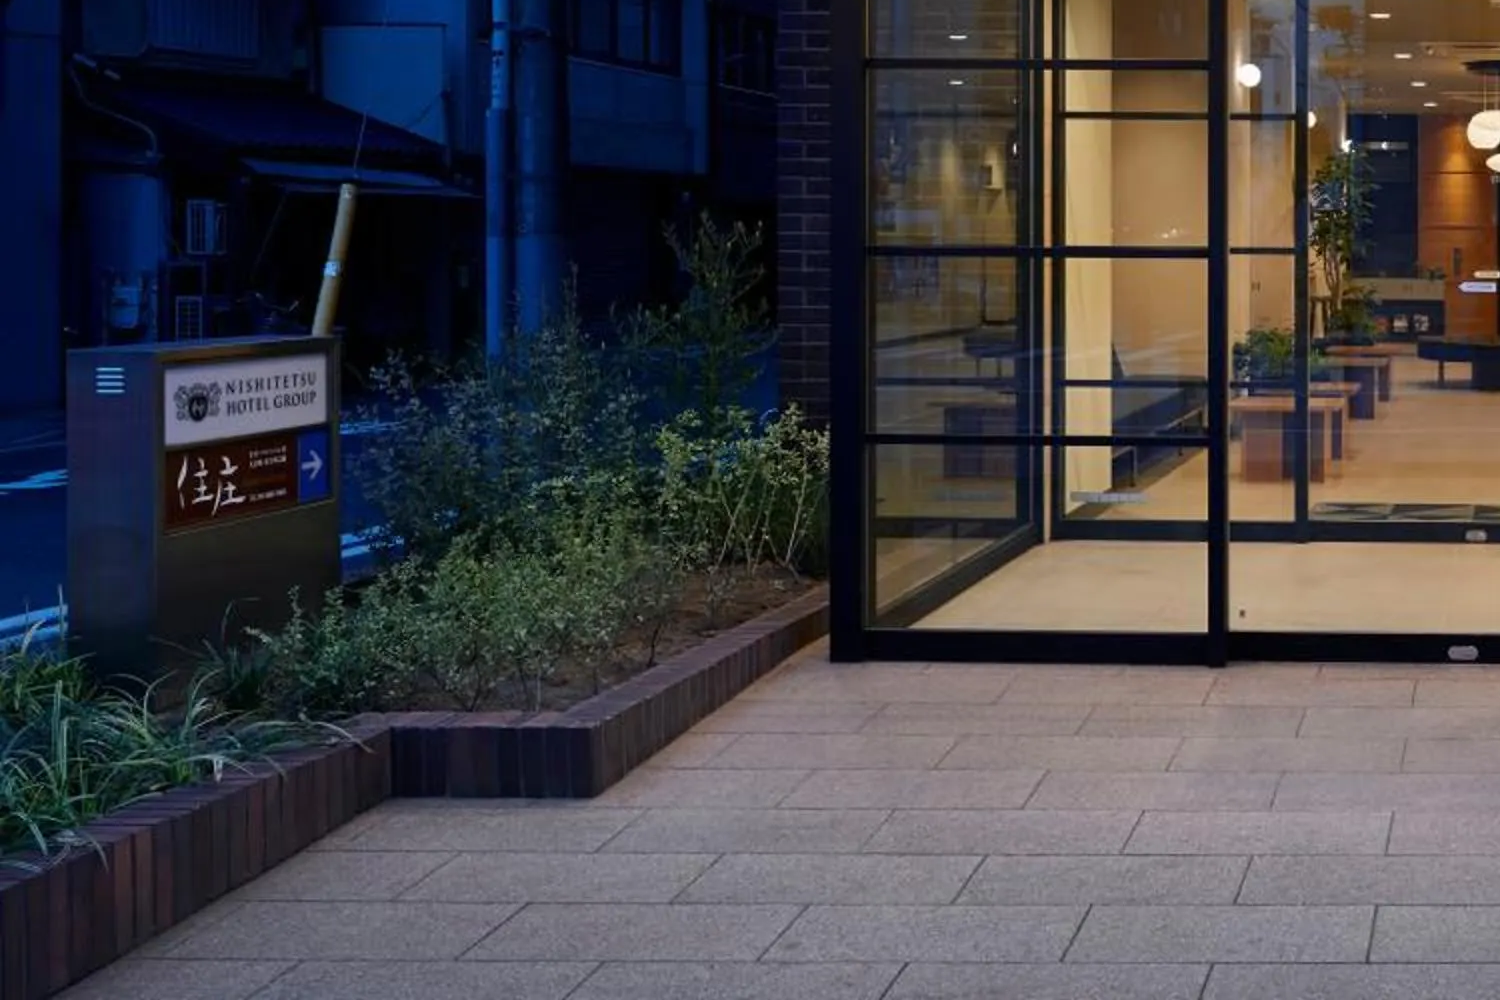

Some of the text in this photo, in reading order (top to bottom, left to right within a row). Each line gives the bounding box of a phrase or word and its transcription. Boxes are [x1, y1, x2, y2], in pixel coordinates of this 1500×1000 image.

[225, 371, 317, 394] NISHITETSU
[226, 391, 317, 417] HOTEL GROUP
[176, 454, 247, 518] 住庄
